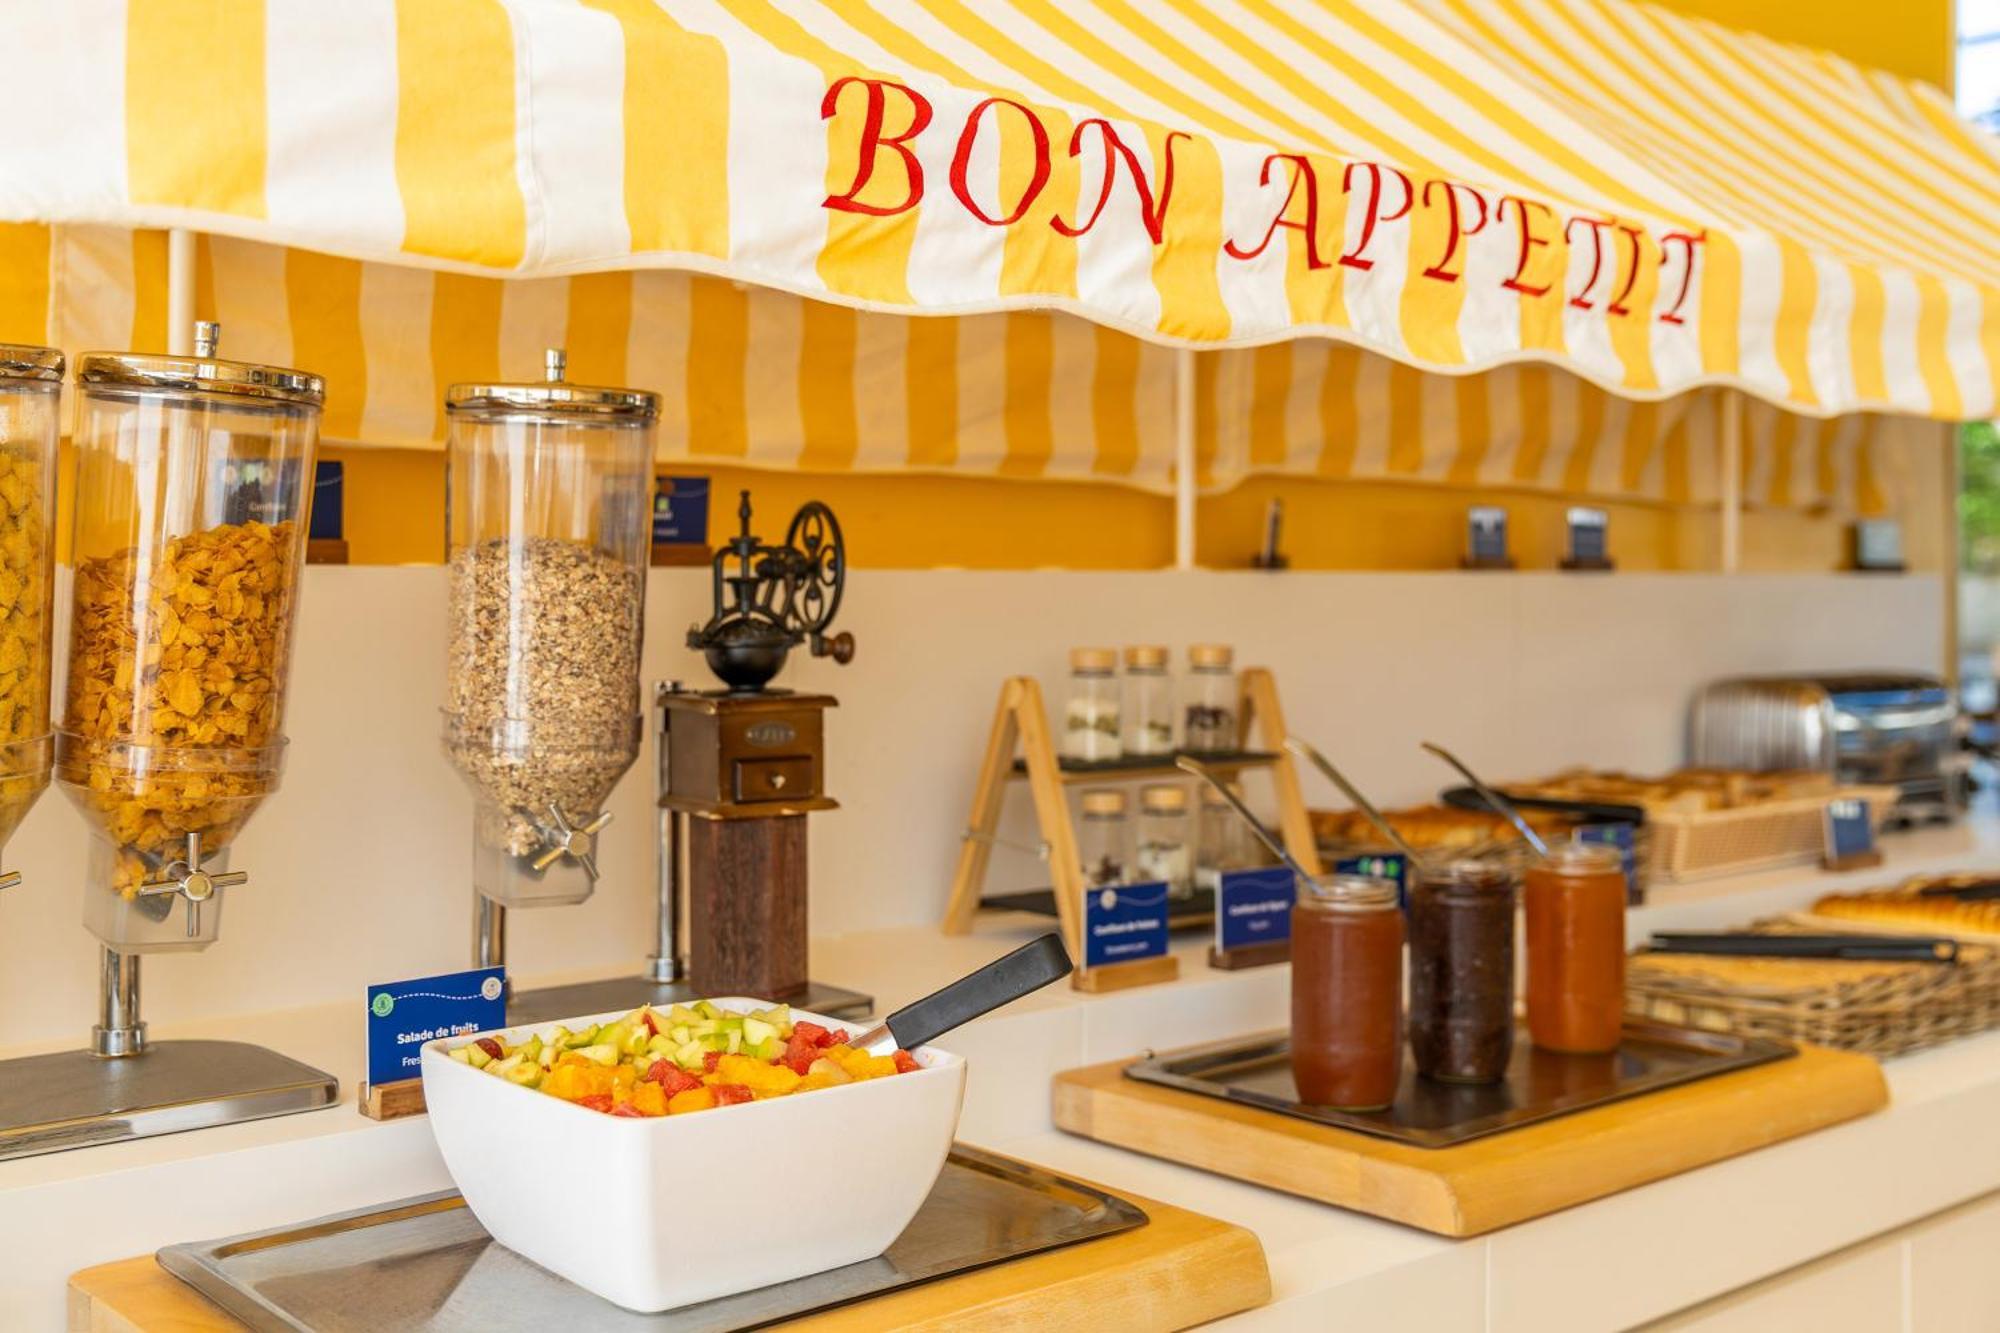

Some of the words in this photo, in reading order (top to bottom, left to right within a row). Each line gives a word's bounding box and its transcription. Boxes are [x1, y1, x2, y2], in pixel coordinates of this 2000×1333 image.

[821, 77, 1192, 245] BON
[1223, 153, 1707, 325] APPETIT
[397, 1030, 434, 1044] Salade
[436, 1027, 449, 1038] de
